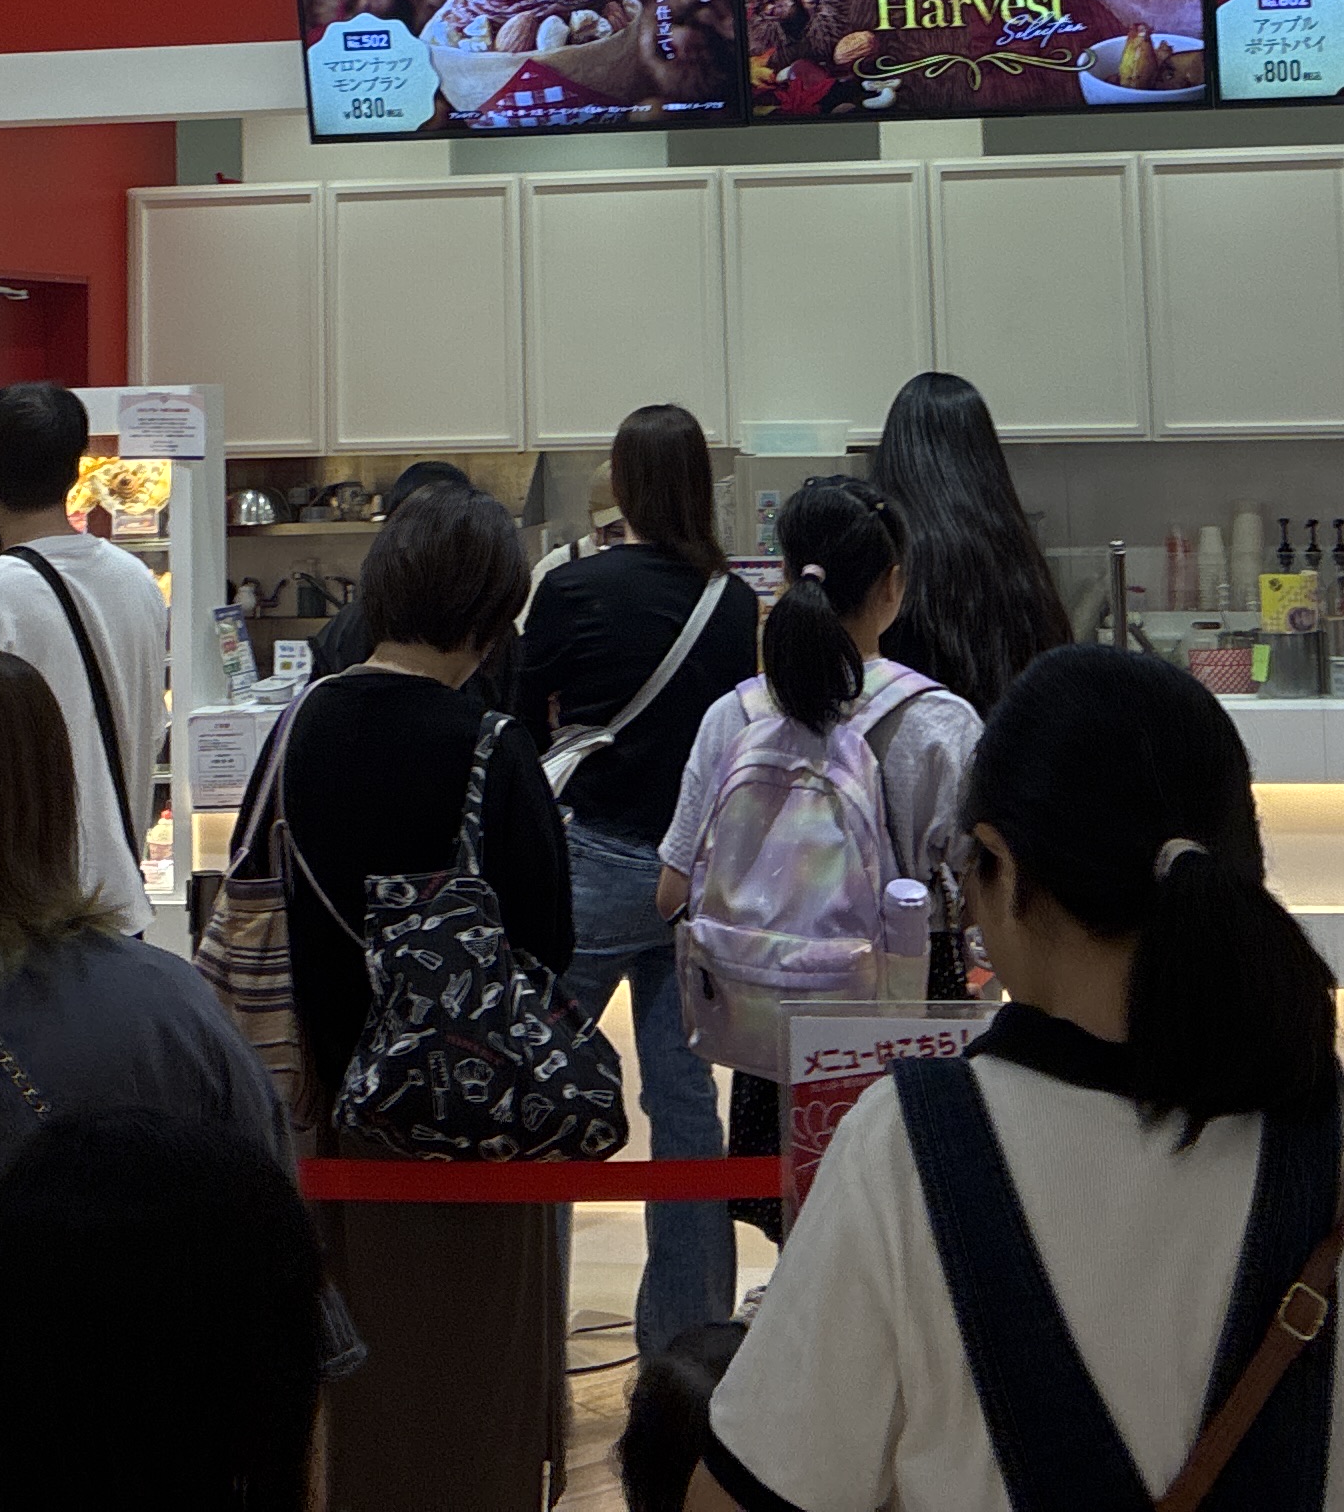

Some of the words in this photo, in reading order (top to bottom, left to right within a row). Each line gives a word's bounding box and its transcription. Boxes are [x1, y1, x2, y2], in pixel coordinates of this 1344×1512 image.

[1244, 36, 1326, 55] ポテトパイ
[323, 57, 413, 73] マロンナッツ
[332, 77, 408, 93] モンブラン
